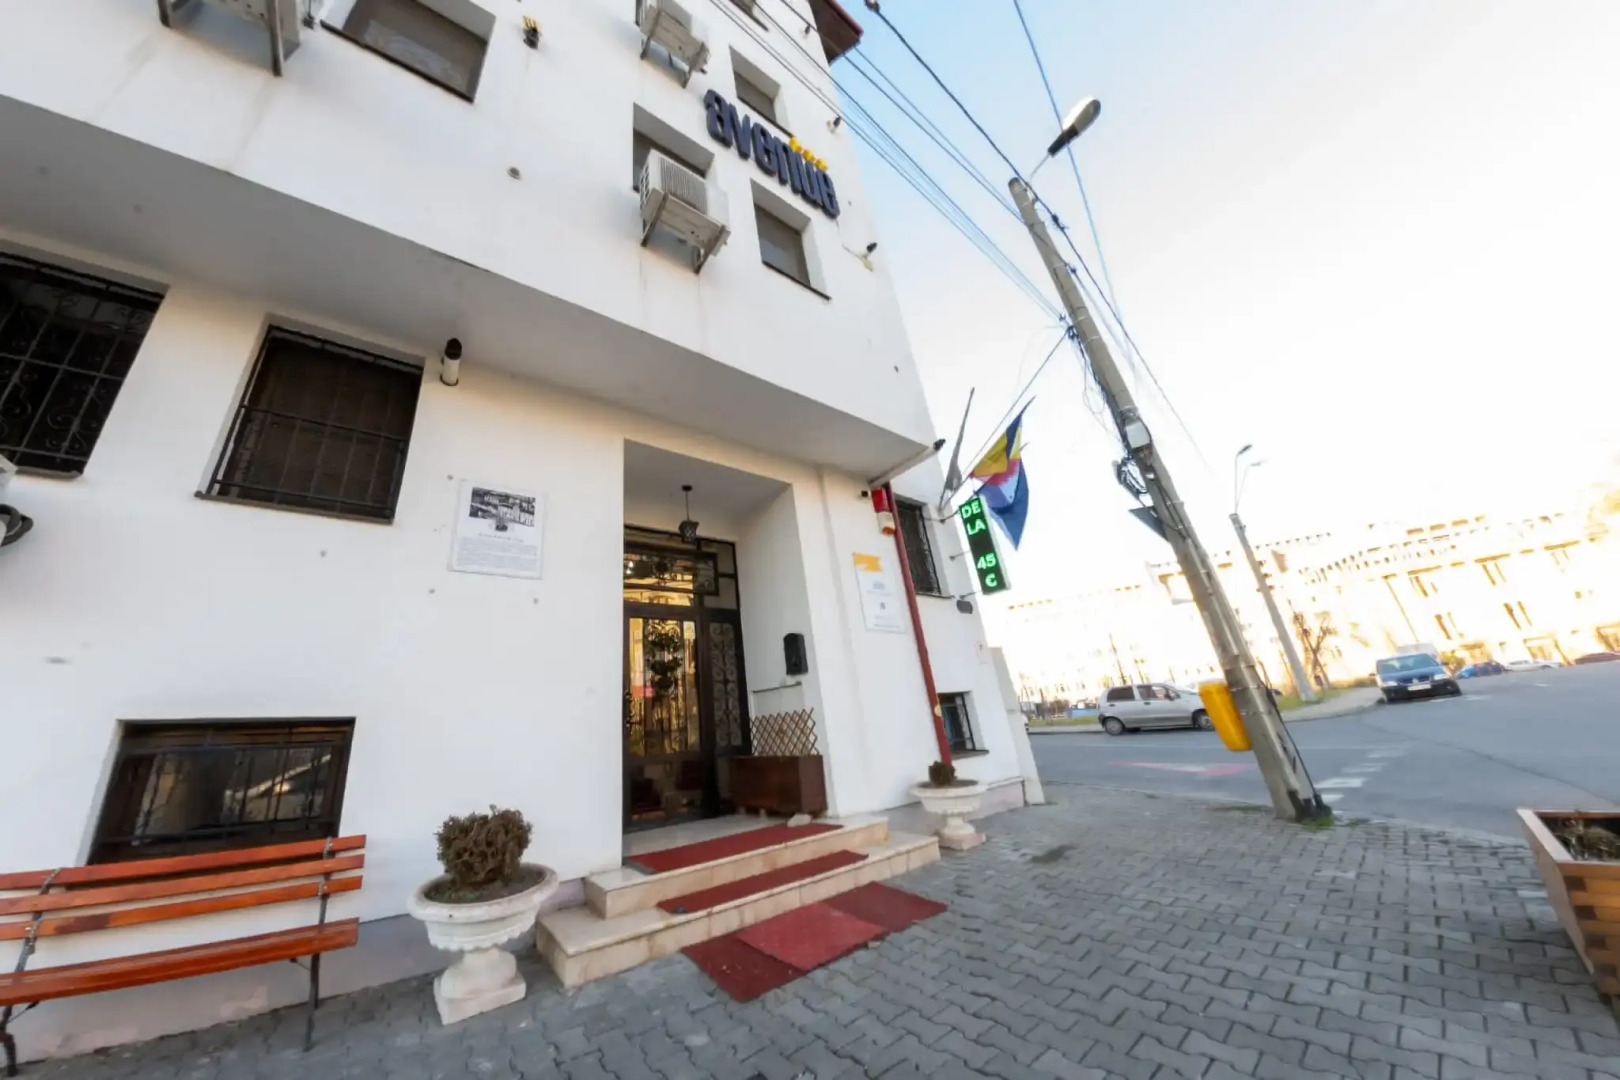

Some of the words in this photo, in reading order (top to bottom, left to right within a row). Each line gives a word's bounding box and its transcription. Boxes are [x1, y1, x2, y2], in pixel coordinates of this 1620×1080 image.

[962, 501, 981, 518] DE
[967, 519, 985, 535] LA
[977, 553, 996, 569] 45
